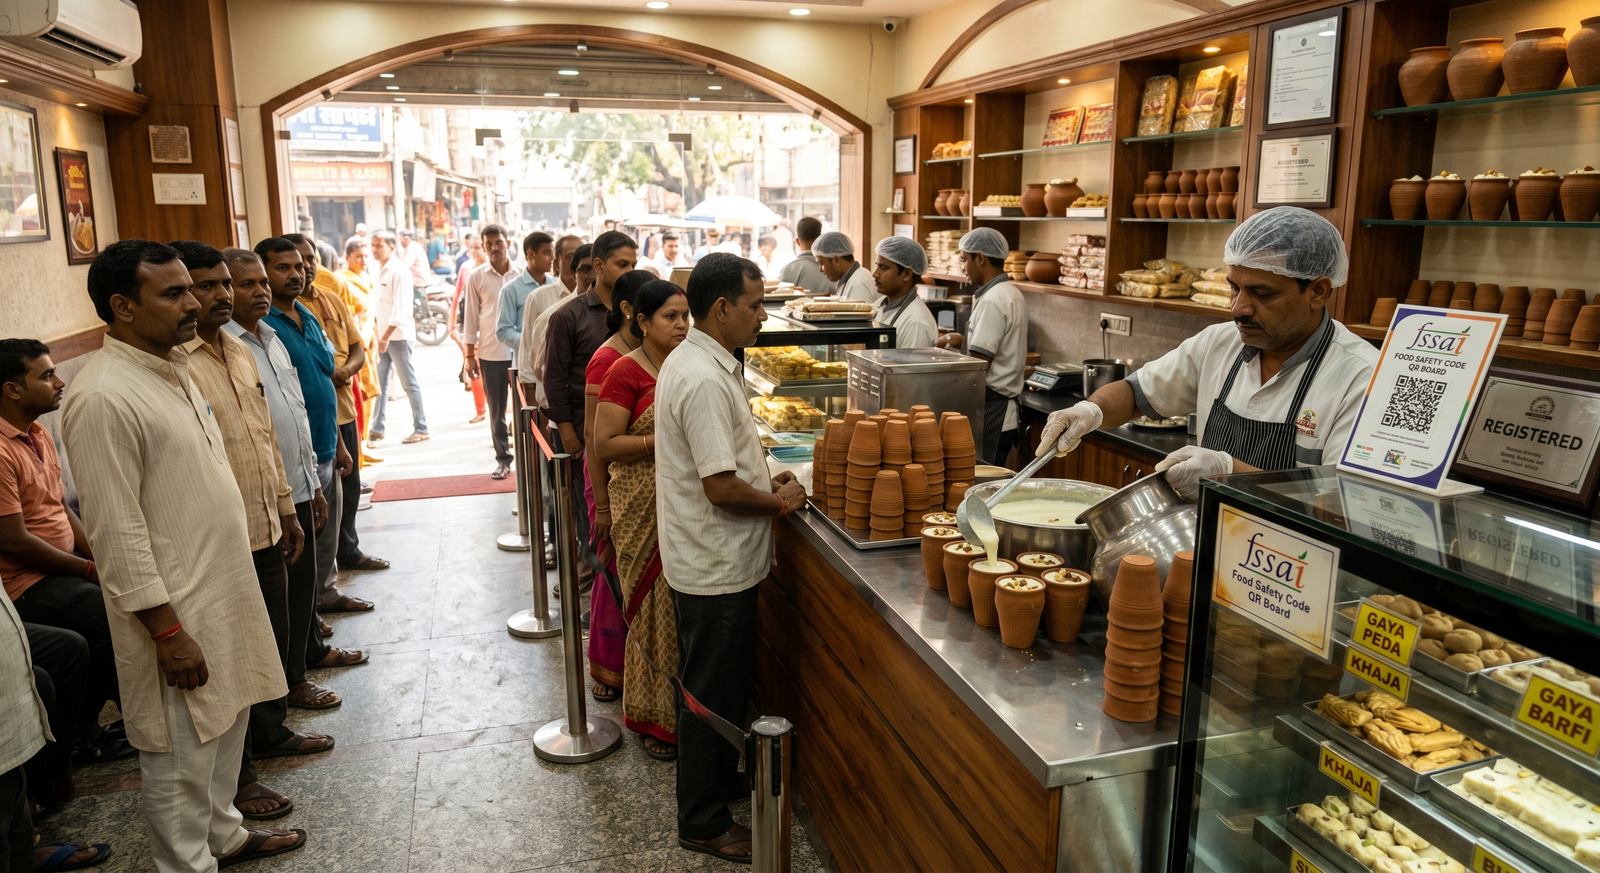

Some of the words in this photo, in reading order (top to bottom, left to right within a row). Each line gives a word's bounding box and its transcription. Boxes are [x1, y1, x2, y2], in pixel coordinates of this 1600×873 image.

[293, 166, 338, 180] SWEETS
[1406, 322, 1471, 355] fssai
[1394, 353, 1414, 361] FOOD
[1415, 356, 1443, 365] SAFETY
[1444, 360, 1467, 369] CODE
[1408, 363, 1420, 372] QR
[1421, 366, 1446, 375] BOARD
[1482, 418, 1583, 451] REGISTERED
[1238, 532, 1307, 589] fssai
[1232, 569, 1253, 587] Food
[1255, 580, 1283, 602] Safety
[1286, 594, 1310, 613] Code
[1248, 591, 1261, 605] QR
[1264, 598, 1290, 619] Board
[1362, 628, 1400, 657] PEDA
[1367, 612, 1404, 640] GAYA
[1351, 655, 1400, 691] KHAJA
[1540, 688, 1593, 724] GAYA
[1528, 703, 1591, 744] BARFI
[1324, 755, 1373, 797] KHAJA
